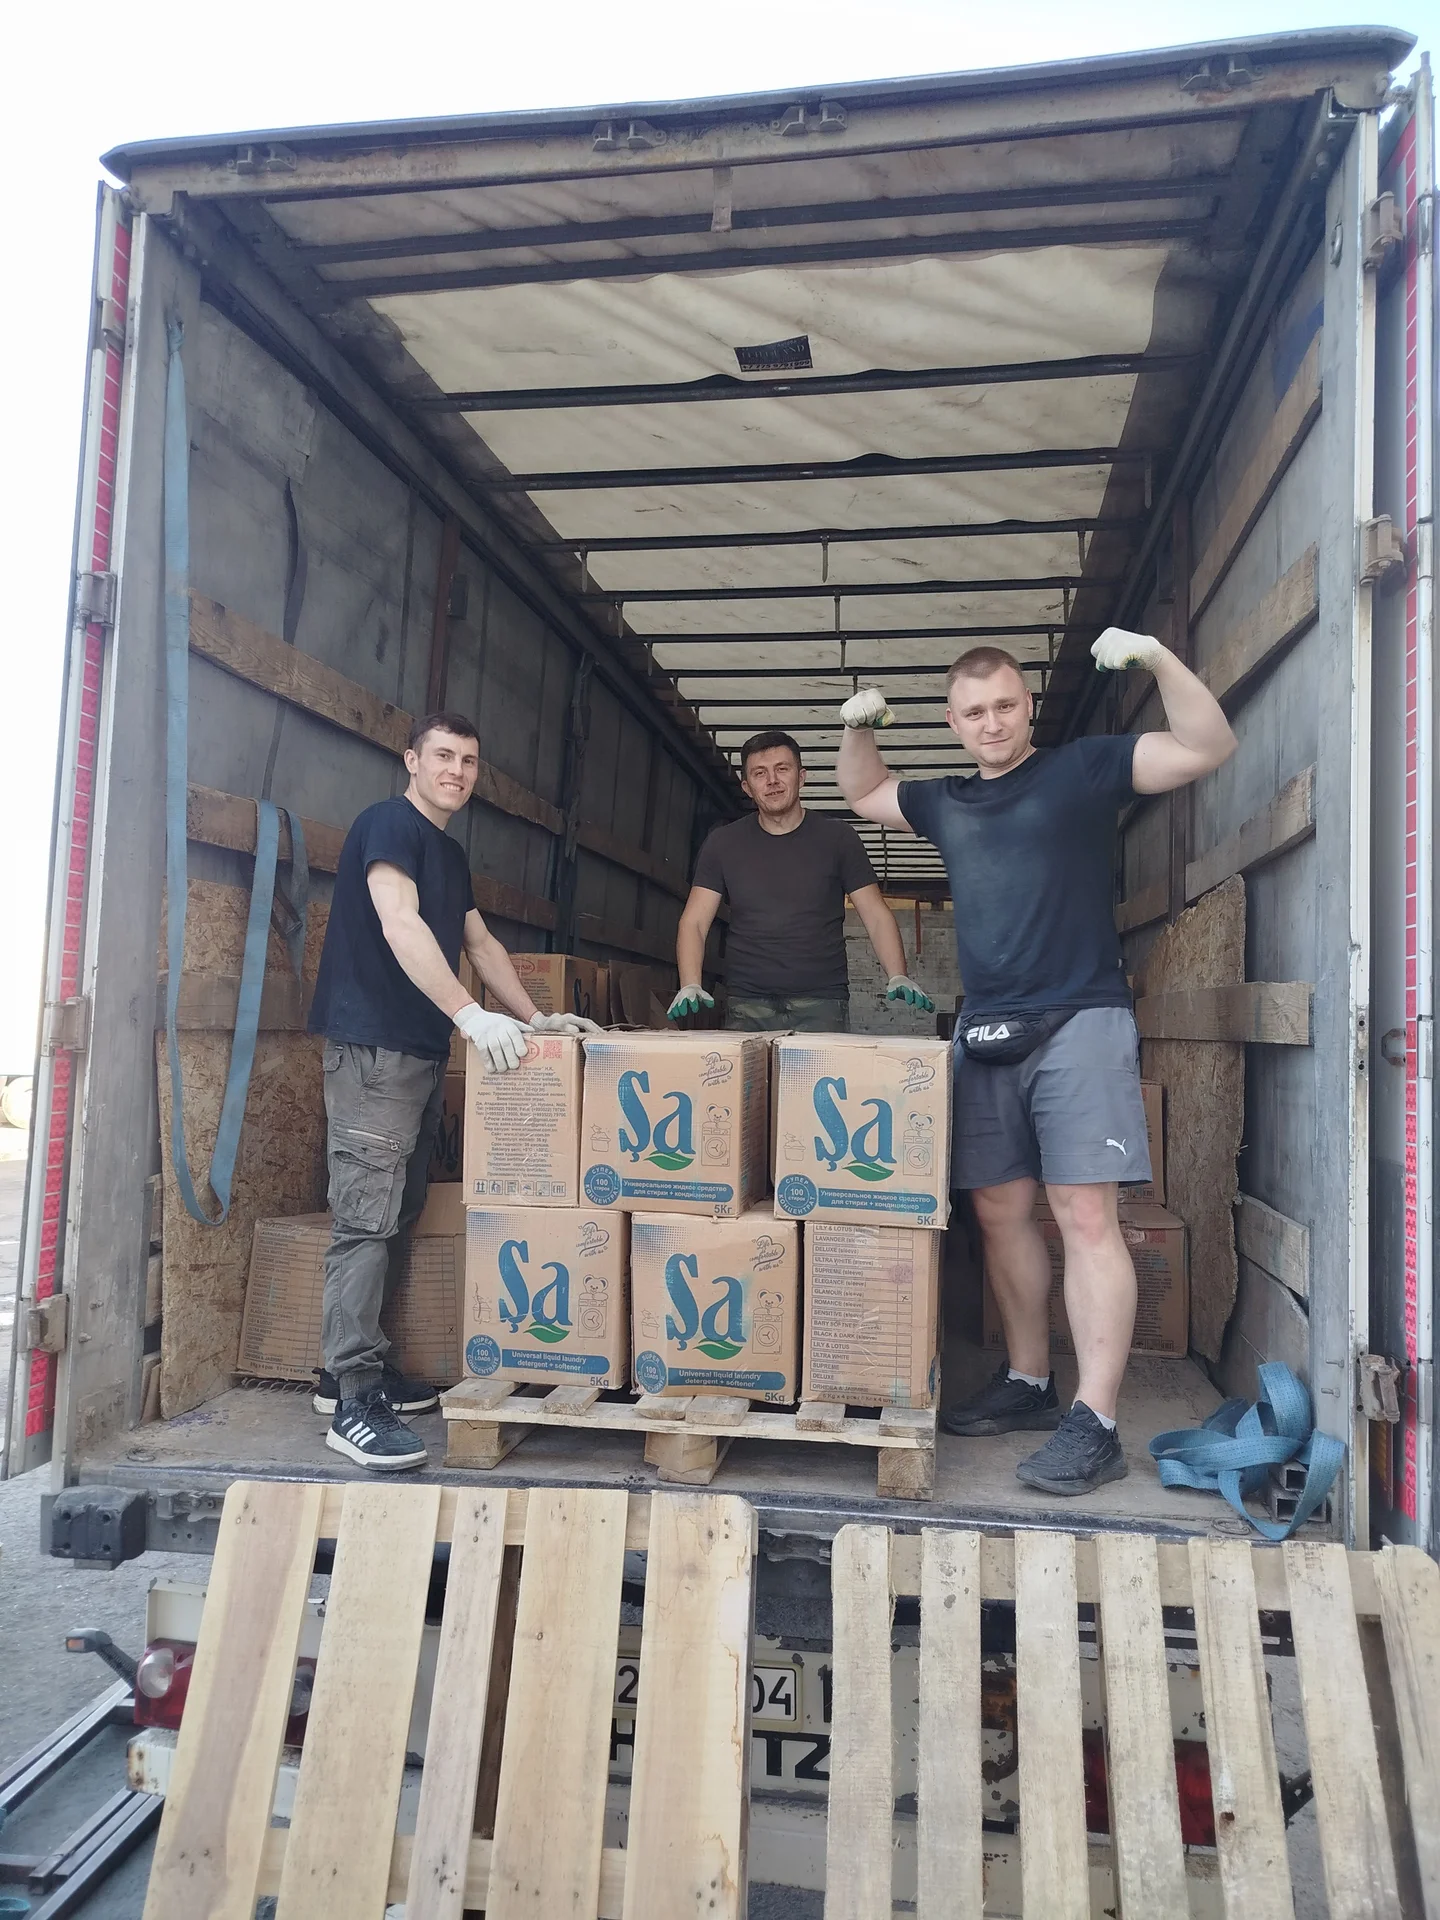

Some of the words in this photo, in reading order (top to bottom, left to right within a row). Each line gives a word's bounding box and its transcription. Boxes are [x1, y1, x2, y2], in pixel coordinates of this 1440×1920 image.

[966, 1024, 1010, 1044] FILA
[592, 1167, 612, 1175] СУПЕР
[624, 1180, 672, 1189] Универсальное
[785, 1177, 809, 1185] СУПЕР
[586, 1184, 618, 1204] КОНЦЕНТРАТ
[778, 1194, 815, 1214] КОНЦЕНТРАТ
[472, 1337, 493, 1346] SUPER
[562, 1356, 586, 1364] laundry
[642, 1354, 660, 1363] SUPER
[467, 1354, 499, 1374] CONCENTRATE
[590, 1377, 609, 1388] 5Kg
[765, 1392, 784, 1403] 5Kg
